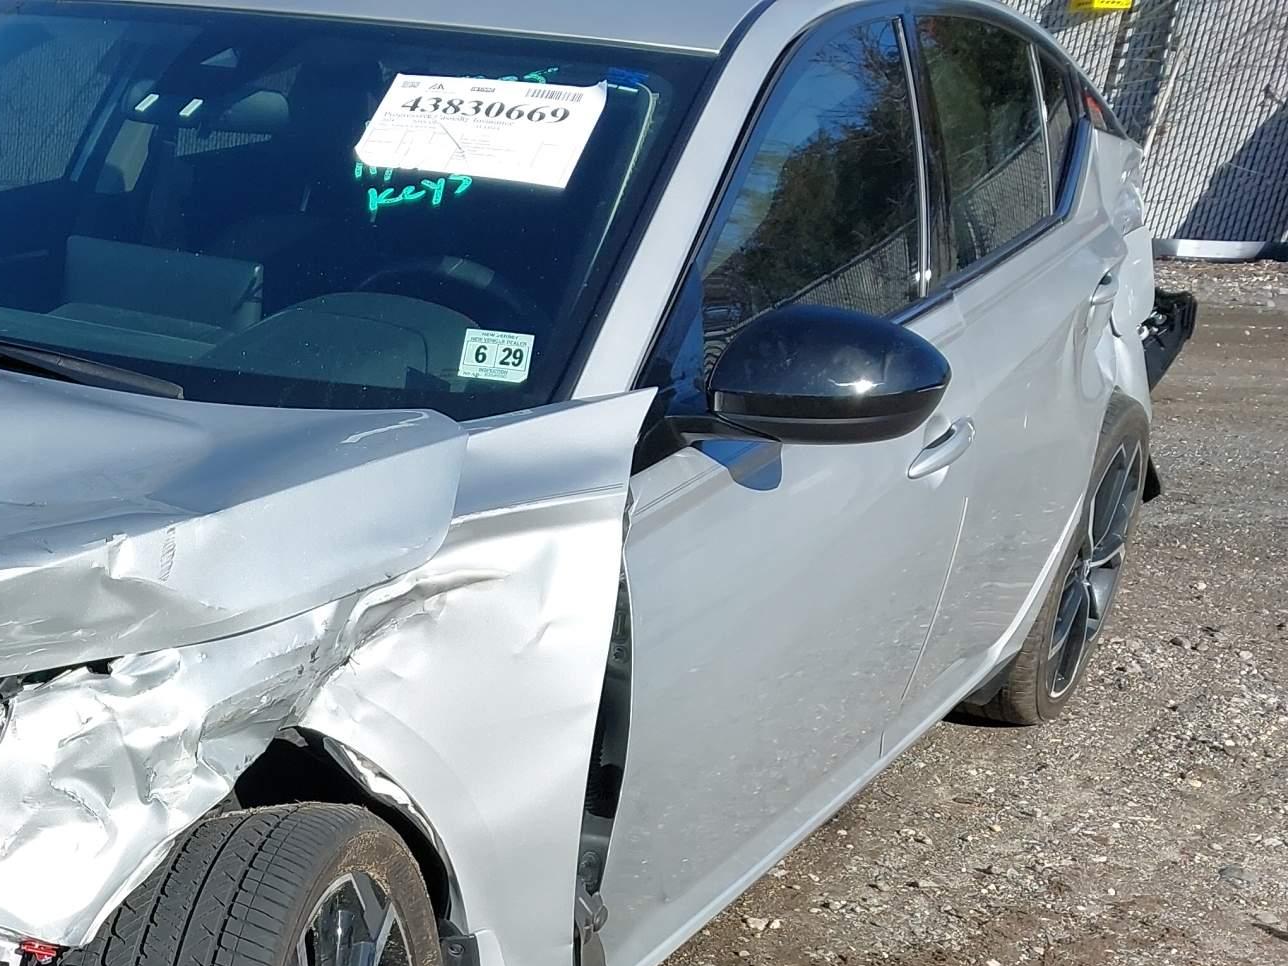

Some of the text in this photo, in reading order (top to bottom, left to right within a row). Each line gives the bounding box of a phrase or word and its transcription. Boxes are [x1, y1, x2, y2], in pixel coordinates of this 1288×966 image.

[401, 96, 570, 124] 43830669
[475, 345, 524, 367] 6 29
